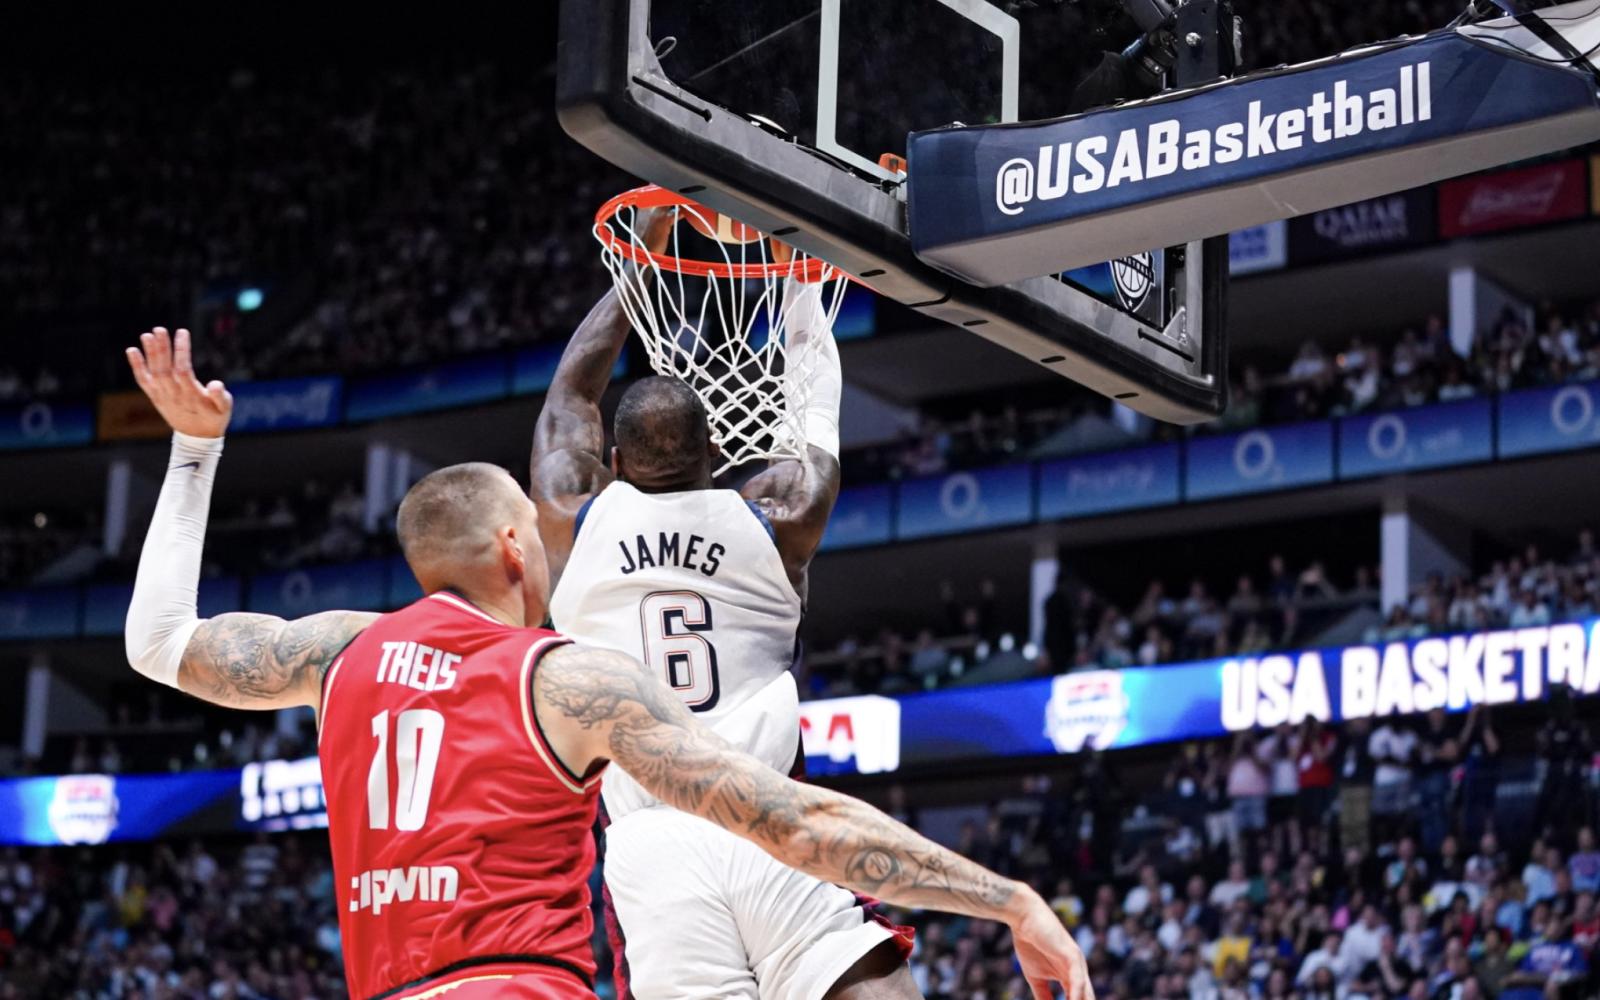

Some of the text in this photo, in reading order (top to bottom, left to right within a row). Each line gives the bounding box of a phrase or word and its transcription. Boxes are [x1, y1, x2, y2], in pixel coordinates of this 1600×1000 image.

[996, 61, 1432, 215] @USABasketball
[619, 531, 726, 577] JAMES
[376, 641, 462, 691] THEIS
[640, 590, 720, 713] 6
[1221, 651, 1331, 731] USA
[367, 709, 445, 831] 10
